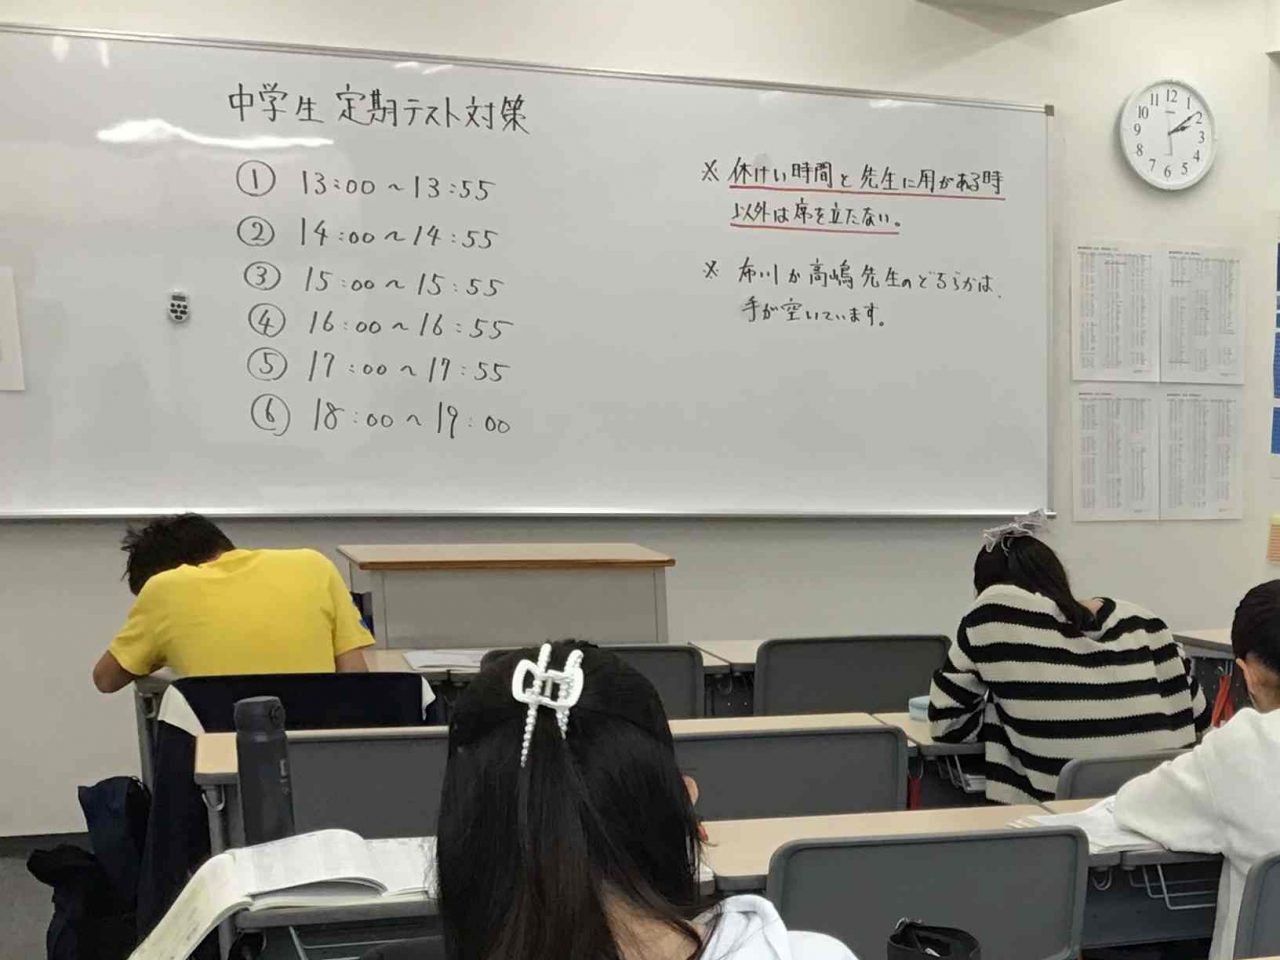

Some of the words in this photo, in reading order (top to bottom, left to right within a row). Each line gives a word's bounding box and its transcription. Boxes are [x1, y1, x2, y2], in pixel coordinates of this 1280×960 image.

[1150, 93, 1159, 106] 11
[1166, 89, 1178, 103] 12
[228, 82, 325, 124] 中学生
[335, 83, 531, 135] 定期テスト対策
[1187, 96, 1191, 110] 1
[1138, 105, 1149, 119] 10
[1196, 111, 1203, 124] 2
[1133, 123, 1142, 136] 9
[1199, 131, 1205, 144] 3
[1136, 143, 1144, 156] 8
[1193, 150, 1200, 162] 4
[1149, 158, 1156, 172] 7
[1164, 165, 1172, 178] 6
[1181, 162, 1188, 175] 5
[731, 198, 901, 227] 以外は席を立たない。
[742, 296, 885, 327] 手が空いています。
